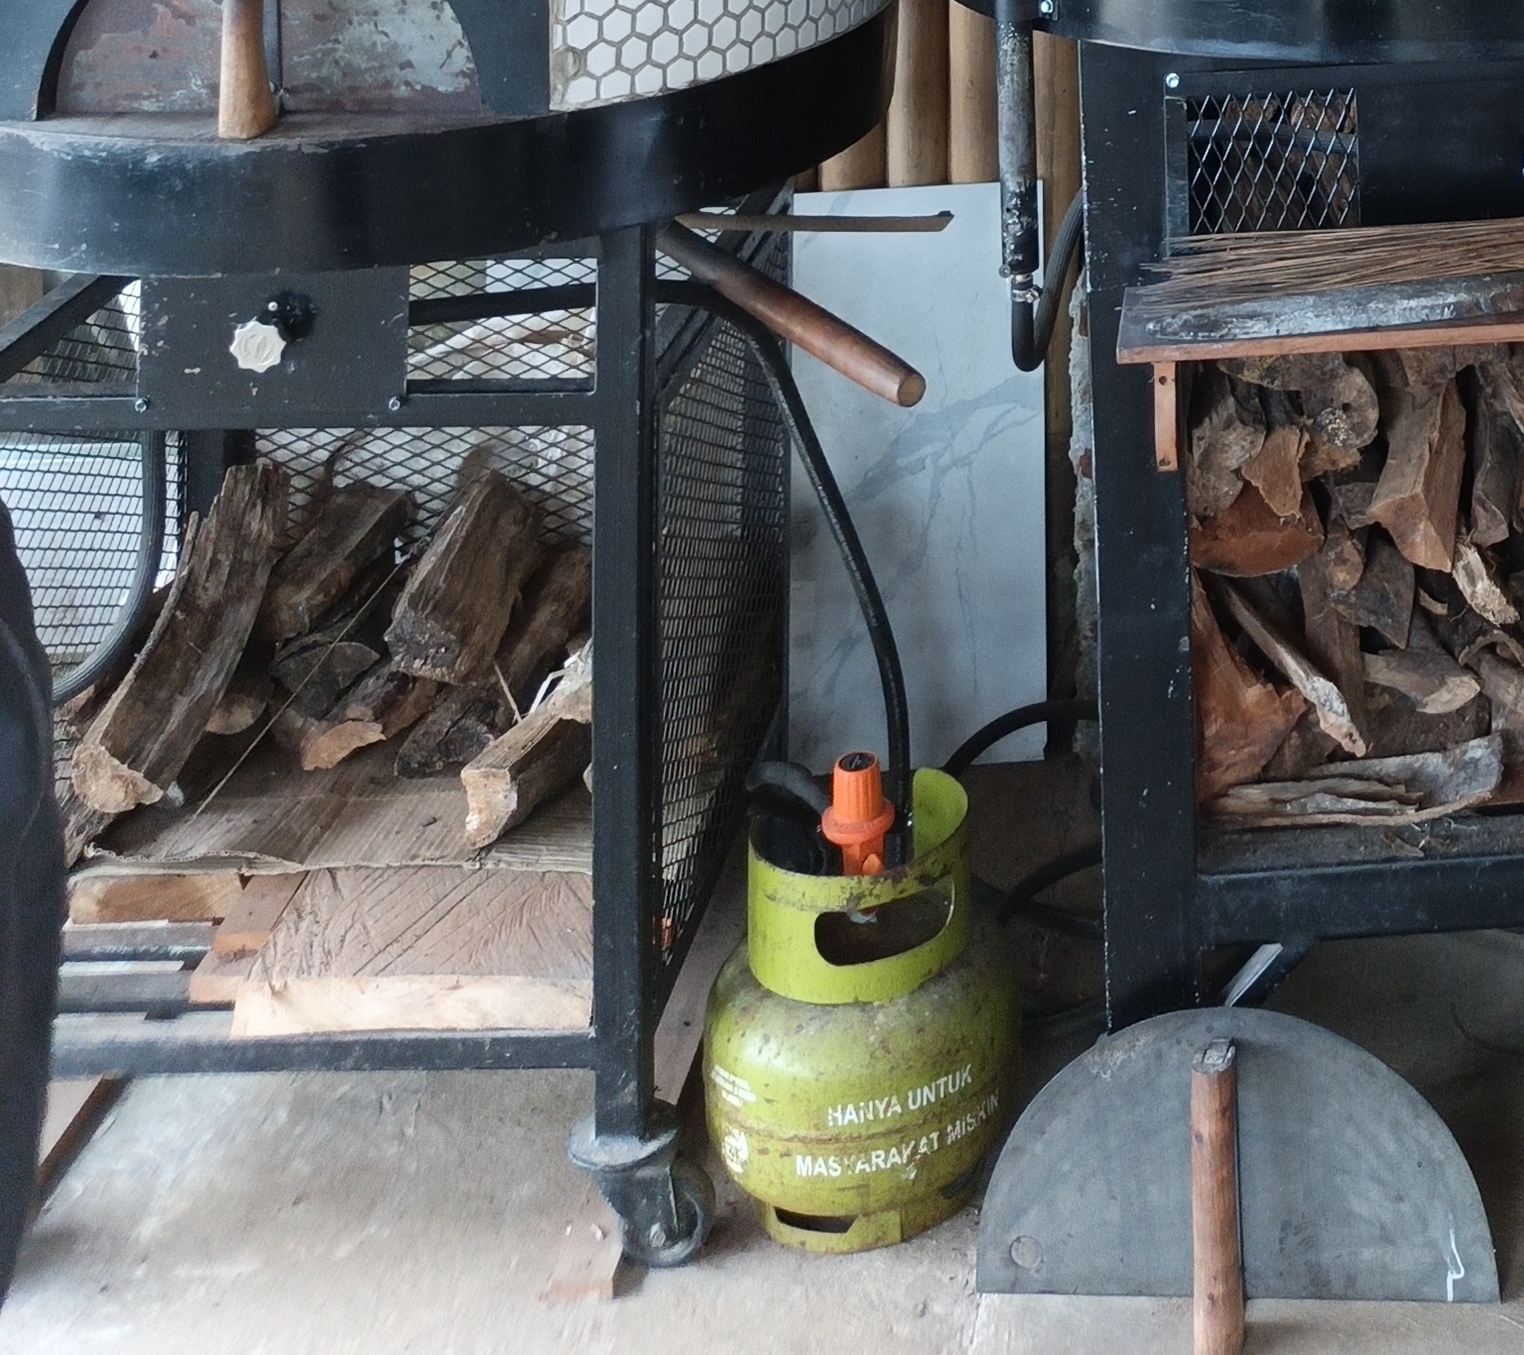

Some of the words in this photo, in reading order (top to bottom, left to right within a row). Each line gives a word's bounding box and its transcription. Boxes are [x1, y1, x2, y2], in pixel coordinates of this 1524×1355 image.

[828, 1095, 902, 1126] HANYA
[907, 1064, 973, 1111] UNTUK
[946, 1089, 1000, 1145] MISKIN
